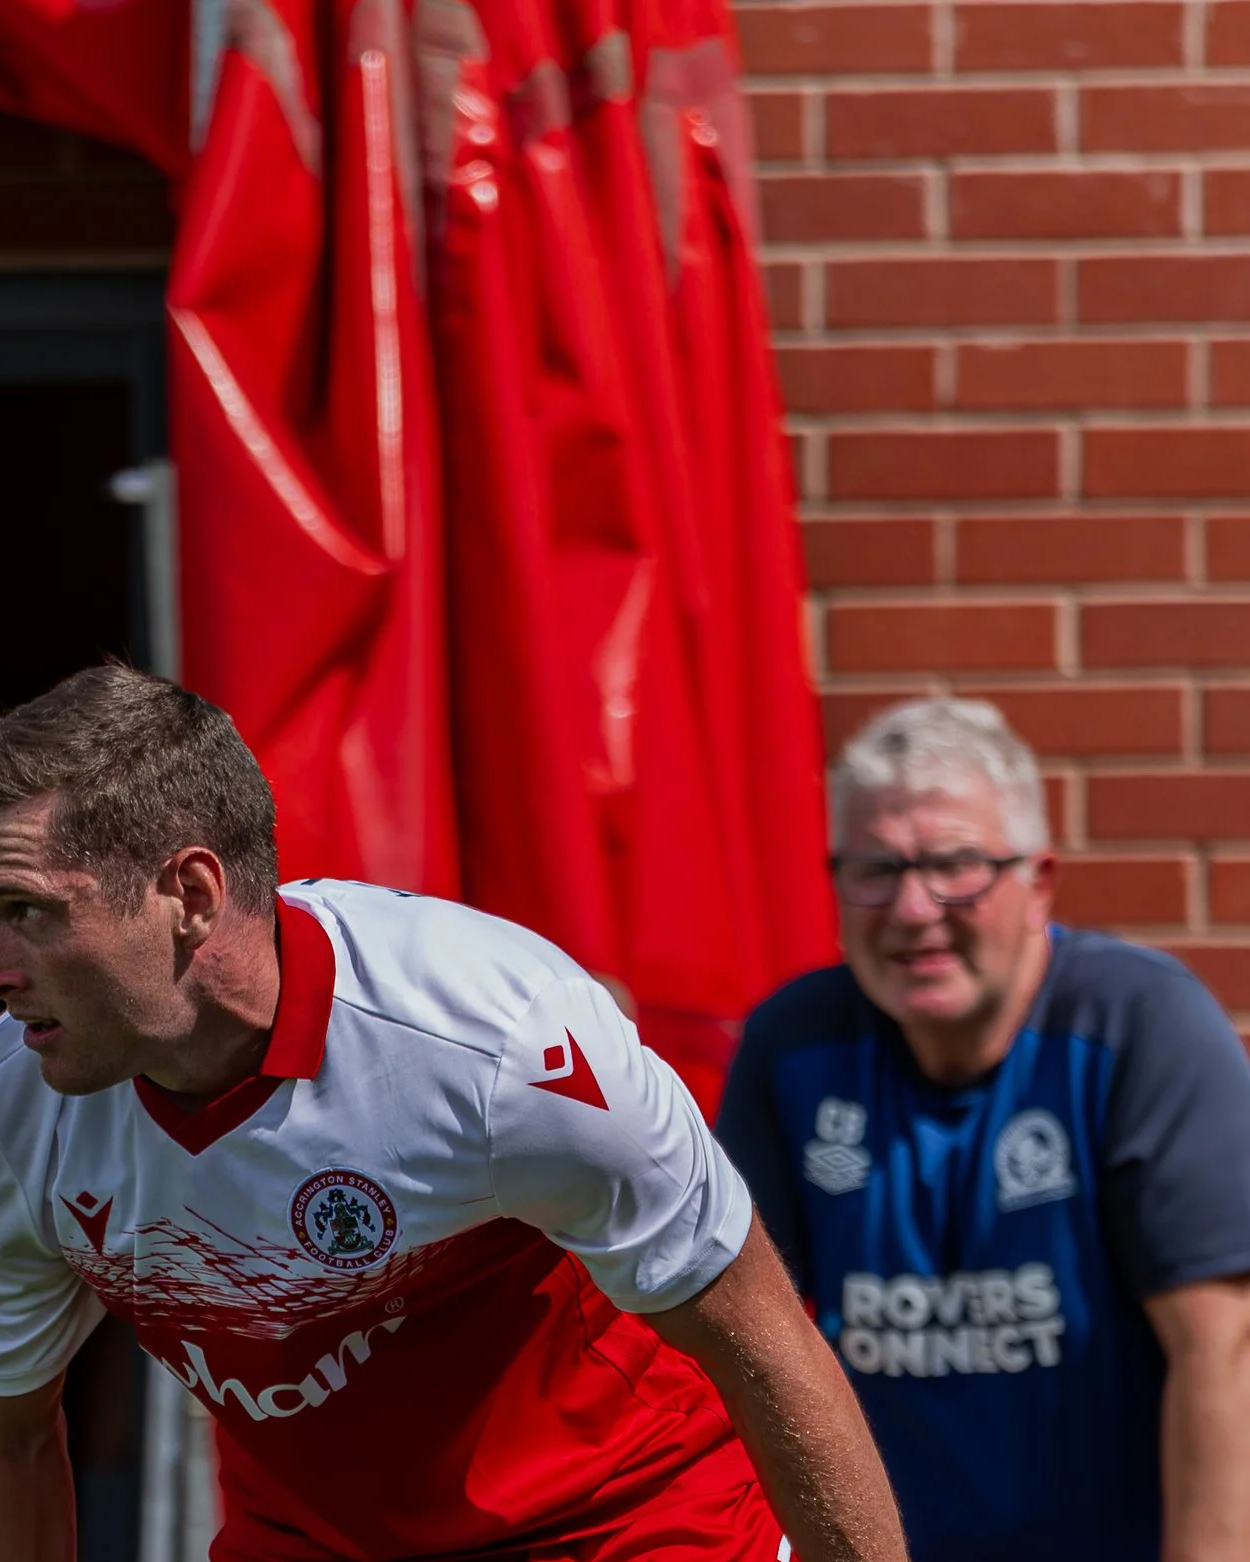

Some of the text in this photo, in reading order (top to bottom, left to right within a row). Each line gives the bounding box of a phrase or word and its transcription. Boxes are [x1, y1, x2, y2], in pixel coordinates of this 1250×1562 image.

[295, 1176, 391, 1227] ACCRINGTON STANLEY
[304, 1229, 394, 1268] FOOTBALL CLUB
